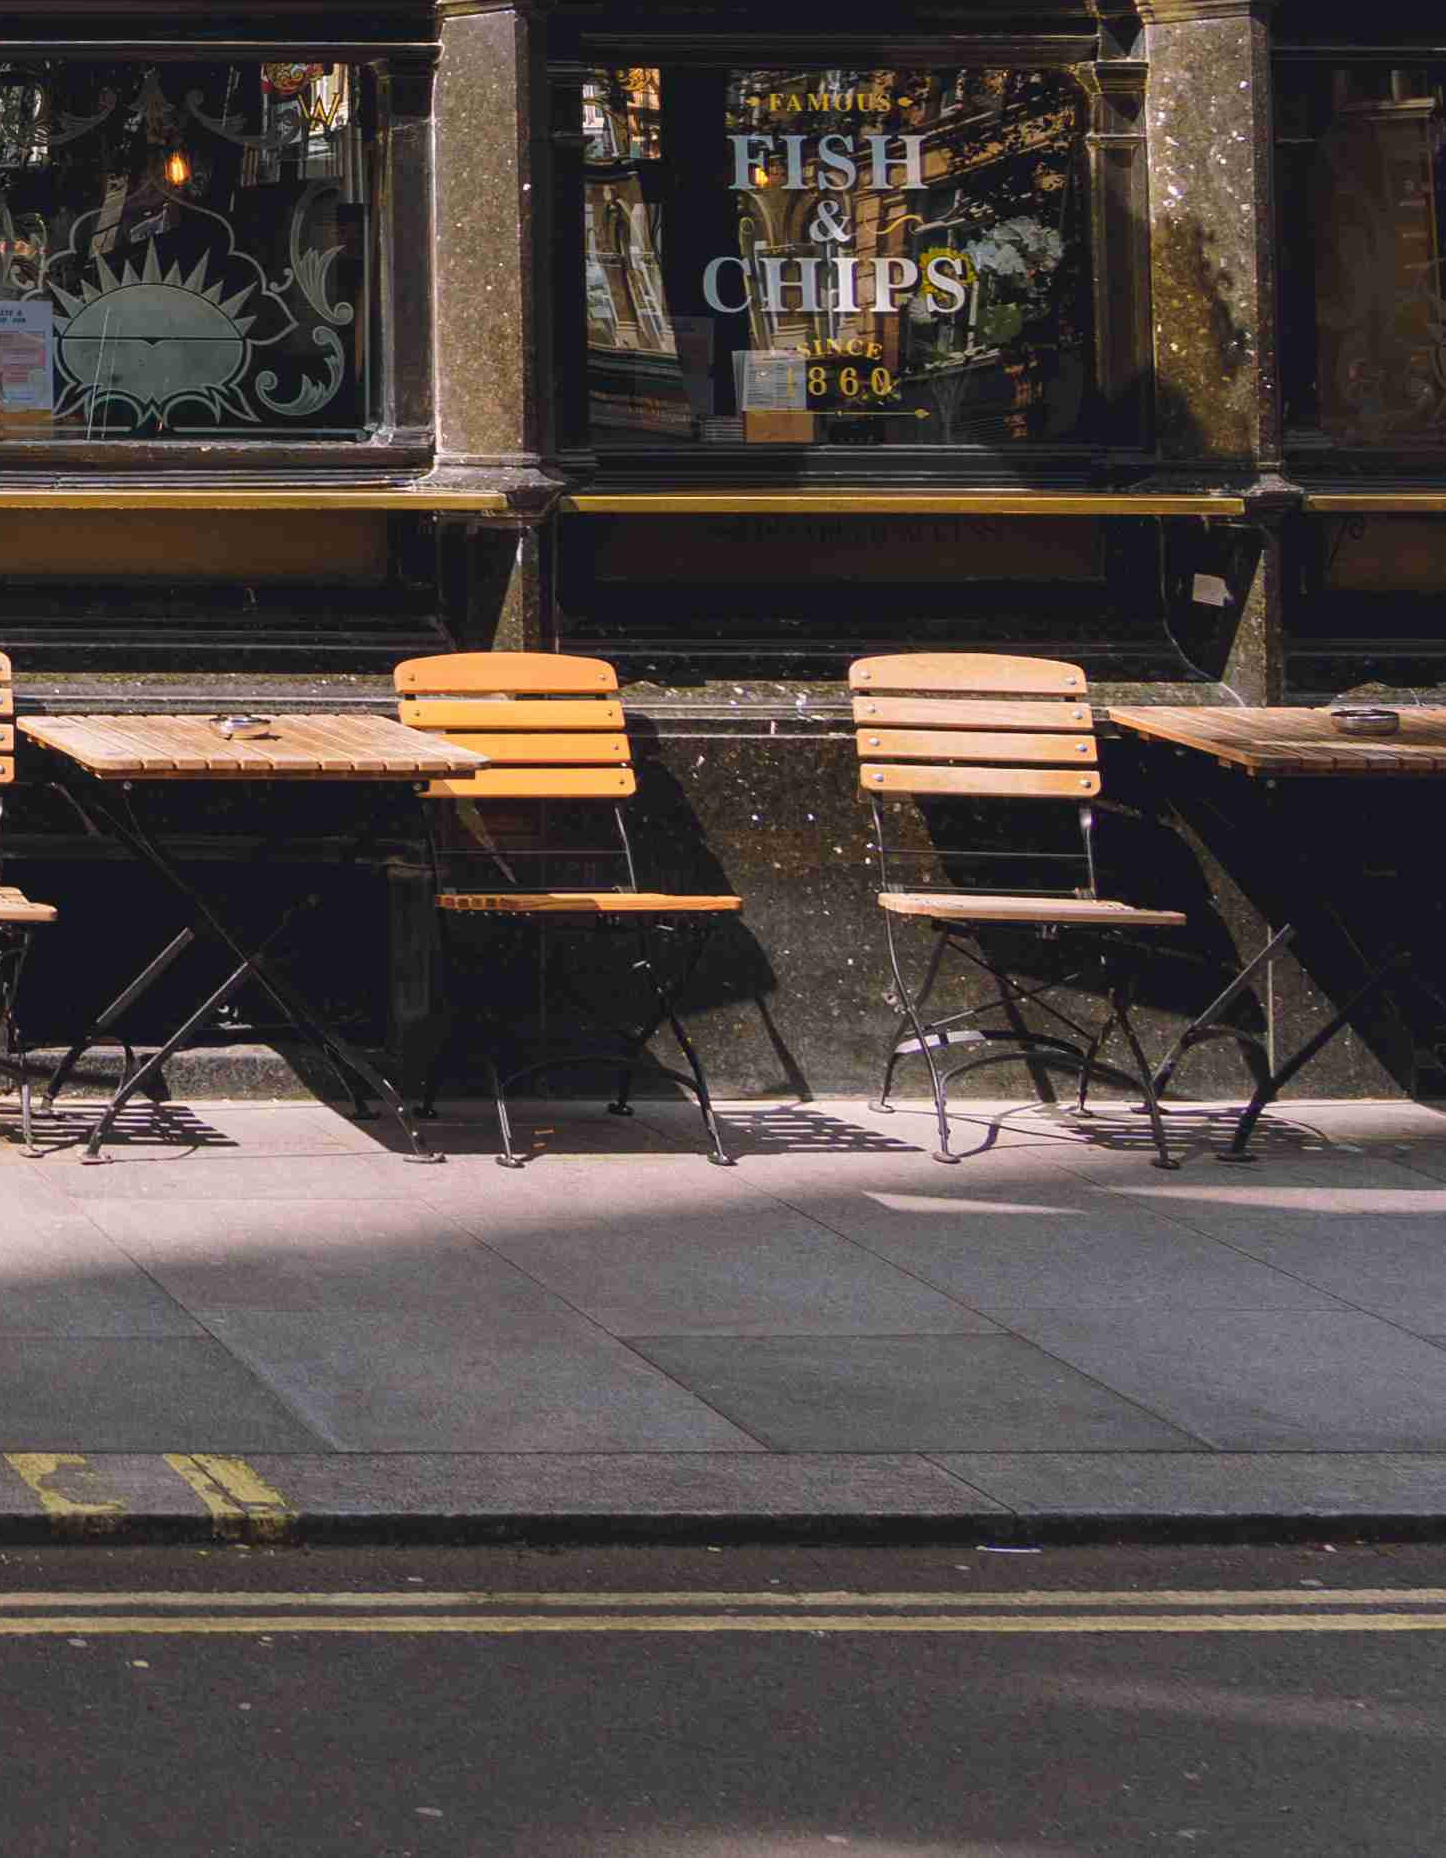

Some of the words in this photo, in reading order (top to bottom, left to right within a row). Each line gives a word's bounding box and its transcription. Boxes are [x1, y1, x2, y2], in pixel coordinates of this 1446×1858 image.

[769, 92, 892, 112] FAMOUS
[727, 133, 930, 191] FISH
[808, 199, 852, 243] &
[702, 255, 970, 314] CHIPS
[796, 338, 884, 361] SINCE
[786, 365, 892, 397] 1860
